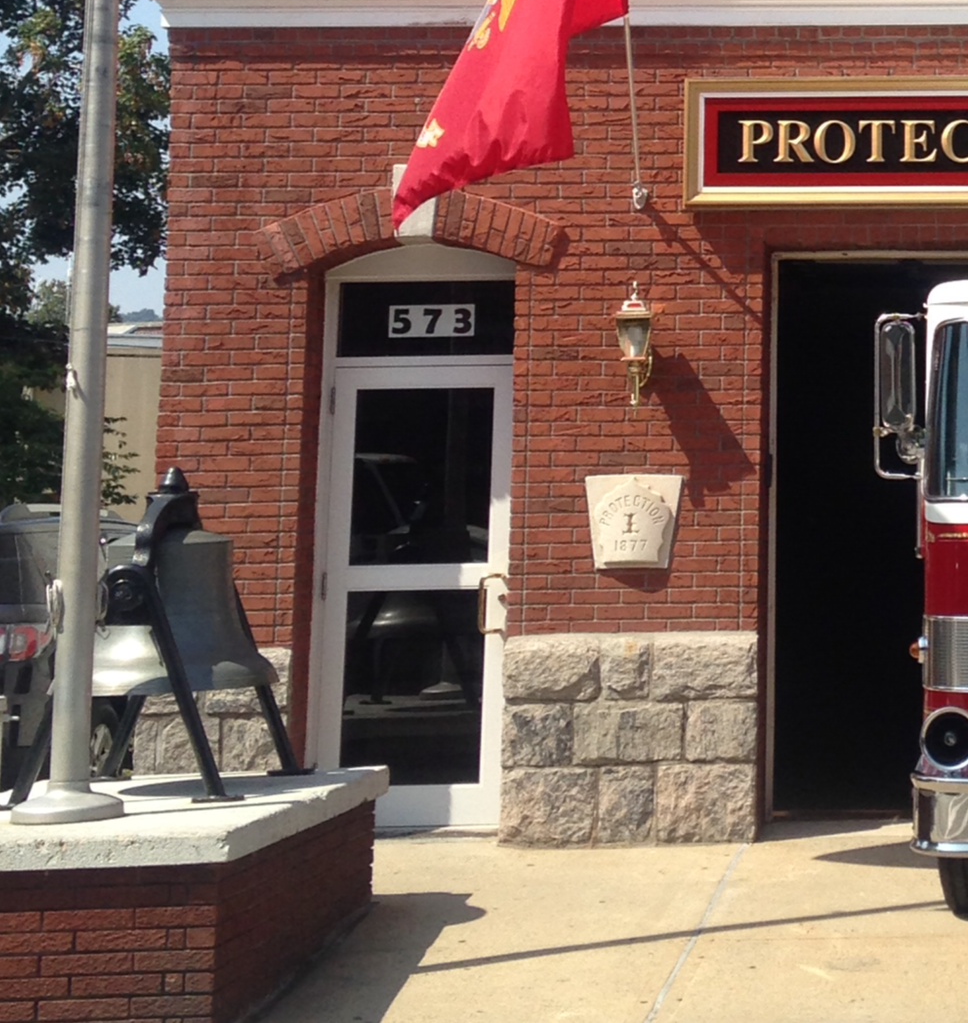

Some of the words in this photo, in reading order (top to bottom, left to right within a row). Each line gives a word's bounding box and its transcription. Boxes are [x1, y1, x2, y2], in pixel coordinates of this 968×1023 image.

[391, 308, 473, 335] 573
[598, 494, 665, 527] PROTECTION
[614, 539, 648, 552] 1877
